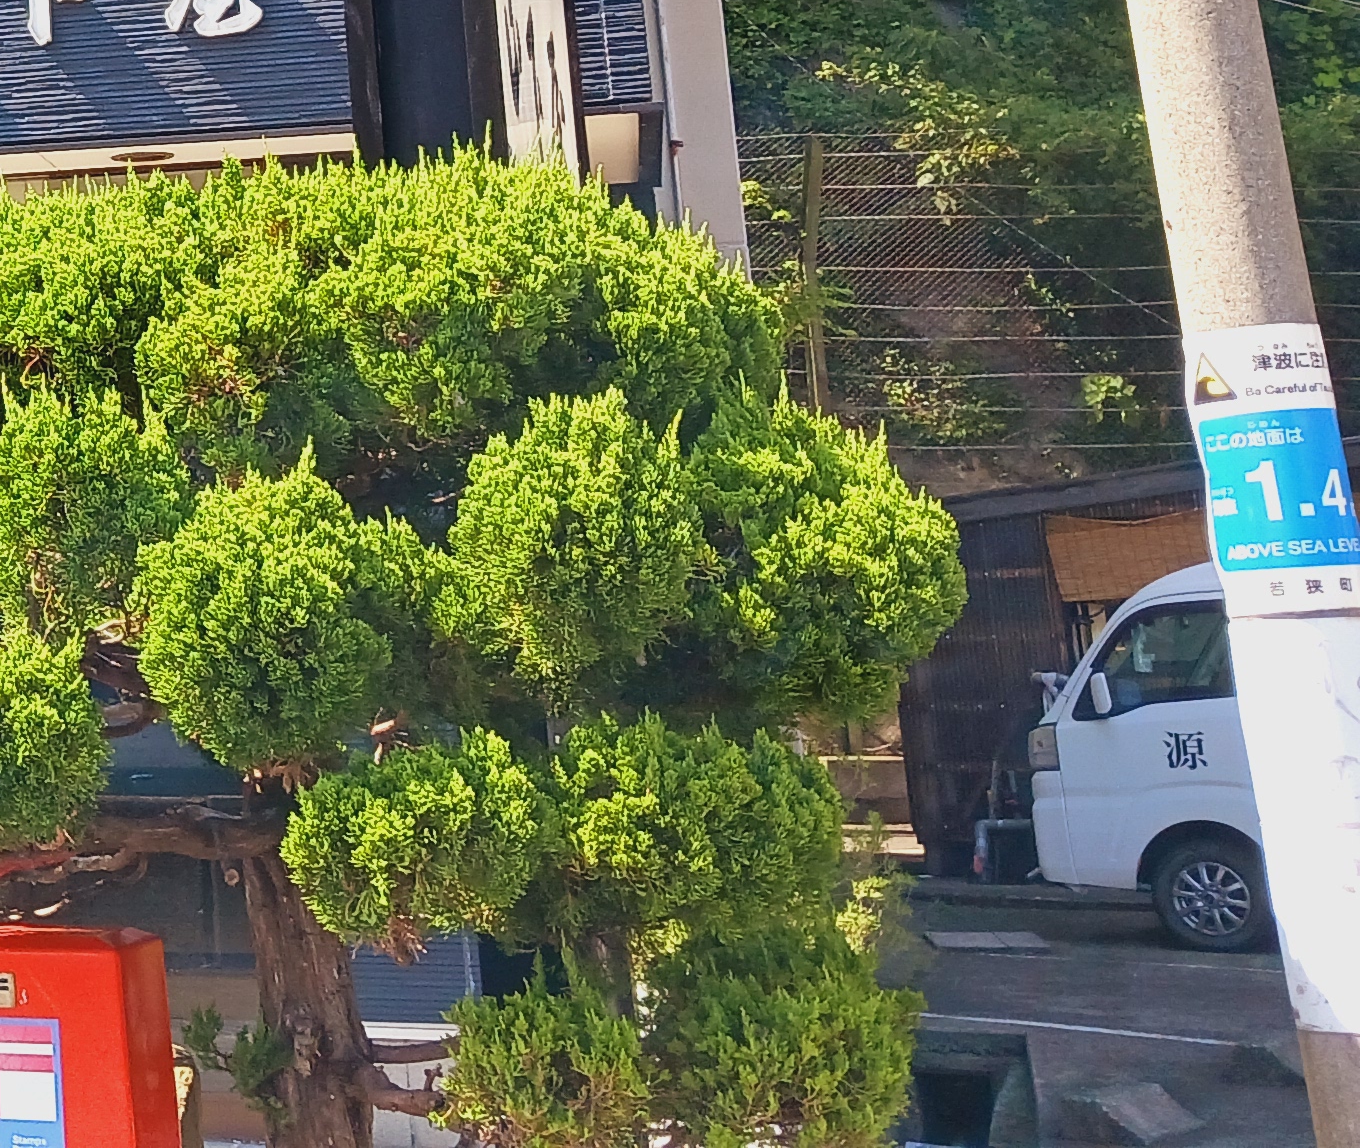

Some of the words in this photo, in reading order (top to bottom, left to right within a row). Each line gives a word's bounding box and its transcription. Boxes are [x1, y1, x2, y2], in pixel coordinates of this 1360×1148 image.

[1264, 383, 1307, 395] Careful
[1205, 427, 1305, 453] ここの地面は
[1226, 542, 1285, 561] ABOVE
[1288, 539, 1327, 555] SEA
[1328, 537, 1360, 552] LEVE
[1162, 730, 1208, 770] 源
